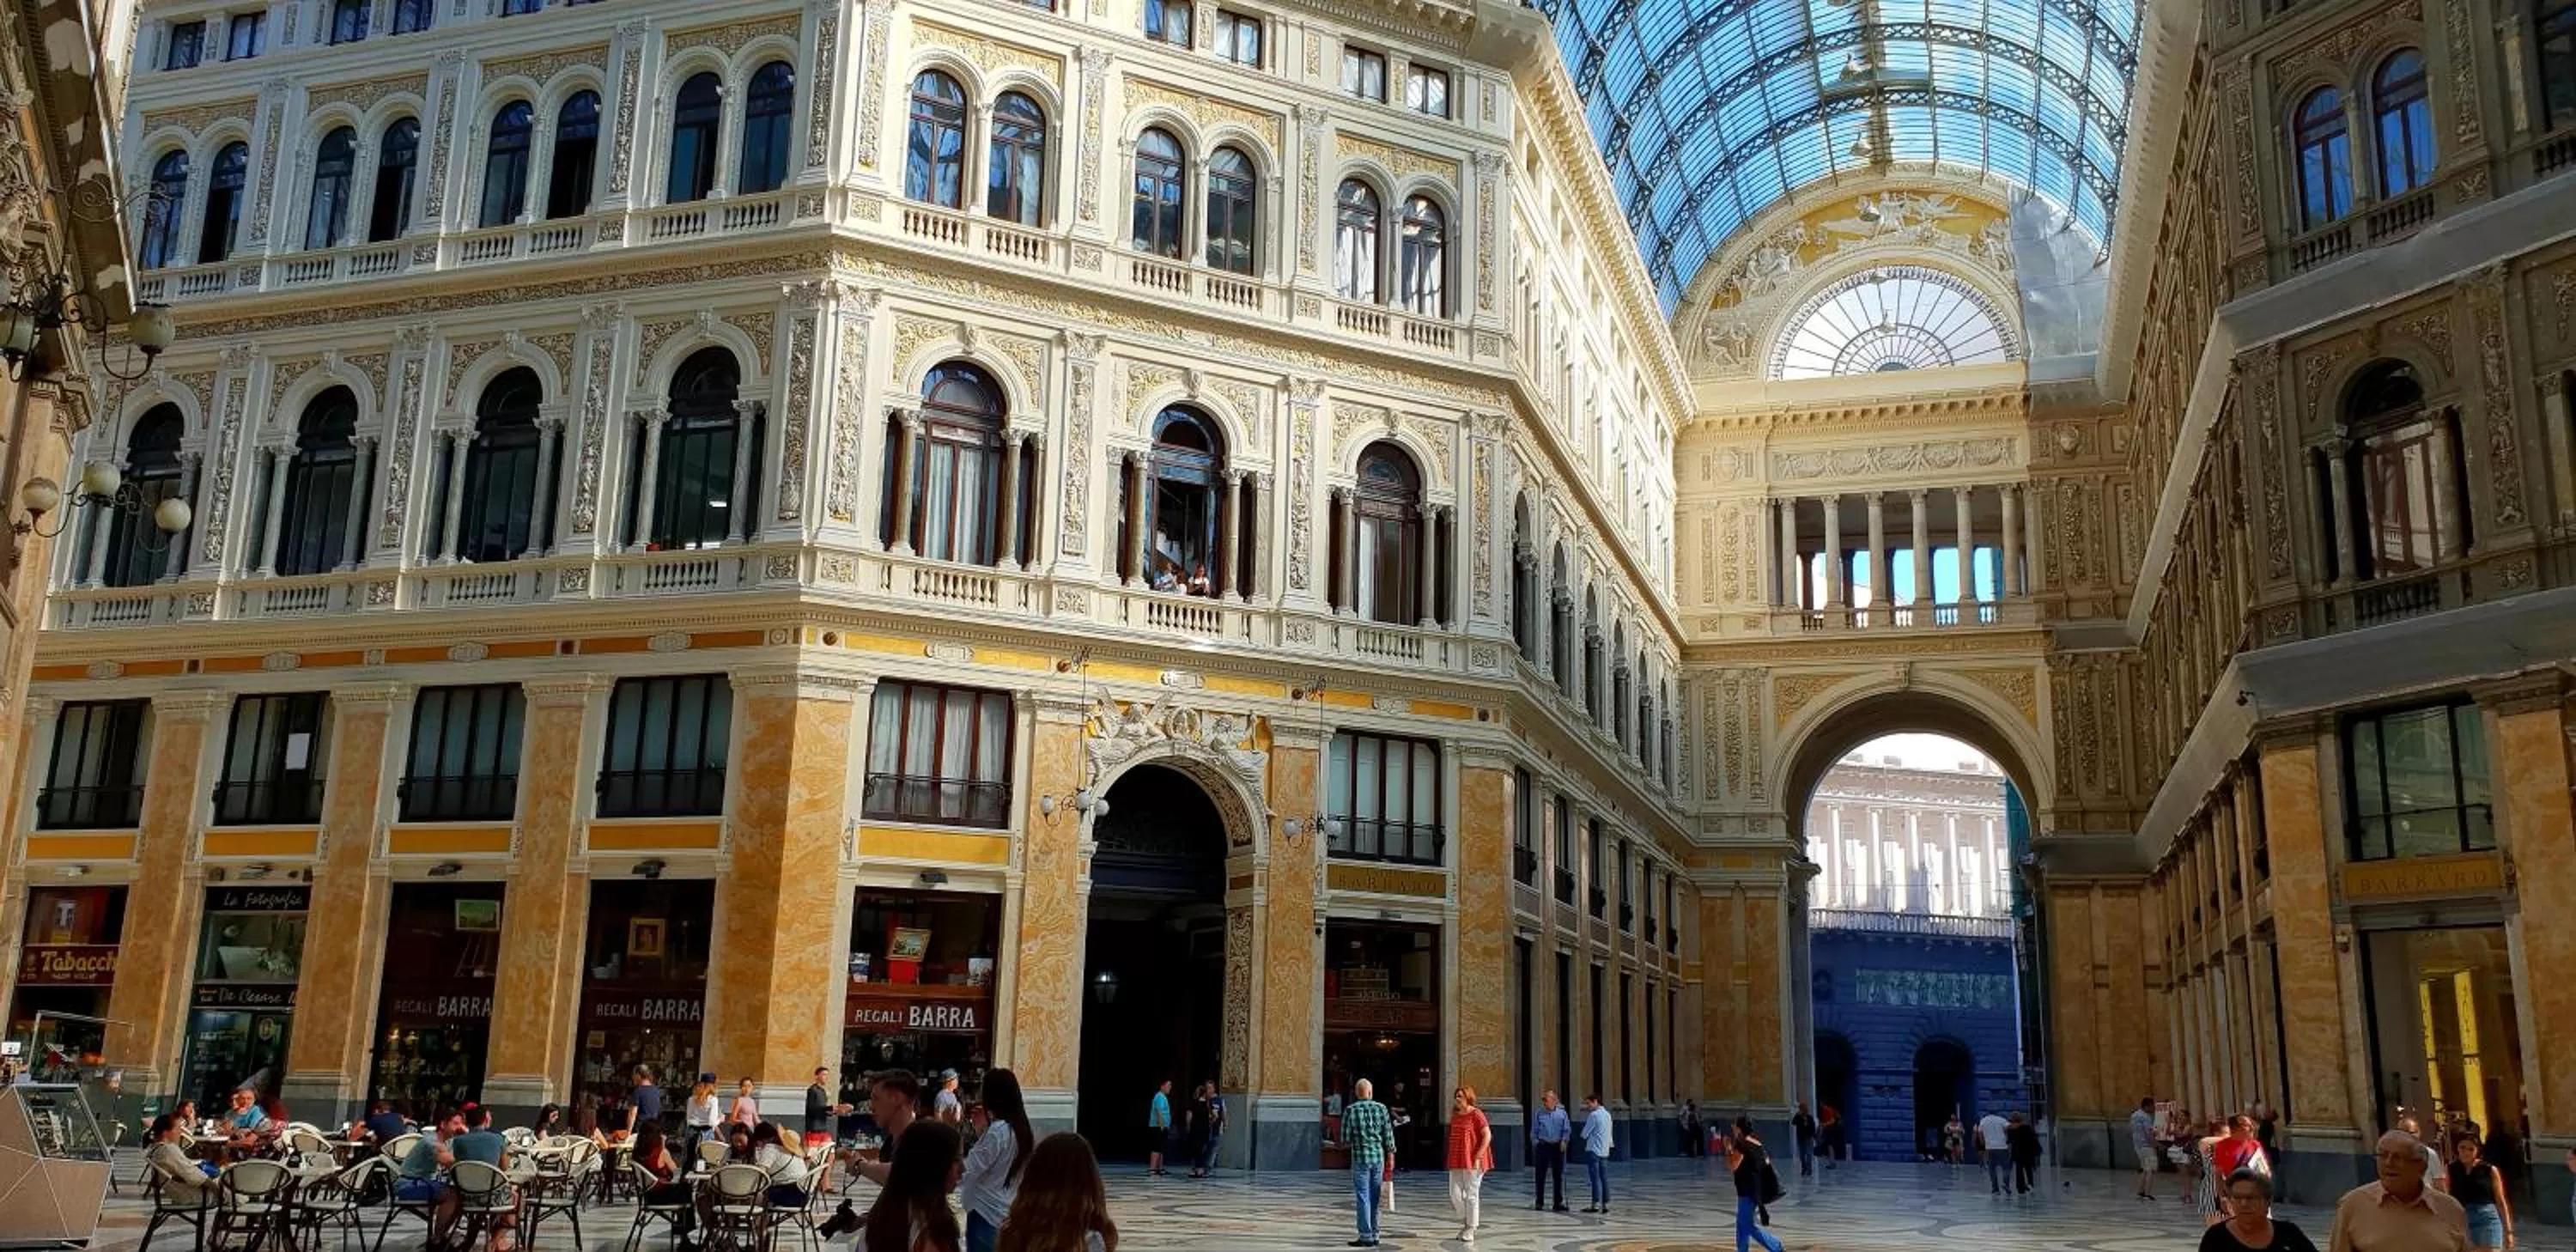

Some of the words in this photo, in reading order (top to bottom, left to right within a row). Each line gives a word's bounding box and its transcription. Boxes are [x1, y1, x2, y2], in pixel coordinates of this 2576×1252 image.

[437, 995, 491, 1018] BARRA
[595, 1002, 638, 1018] REGALI
[641, 998, 702, 1022] BARRA
[854, 1009, 903, 1024] REGALI
[908, 1005, 975, 1028] BARRA
